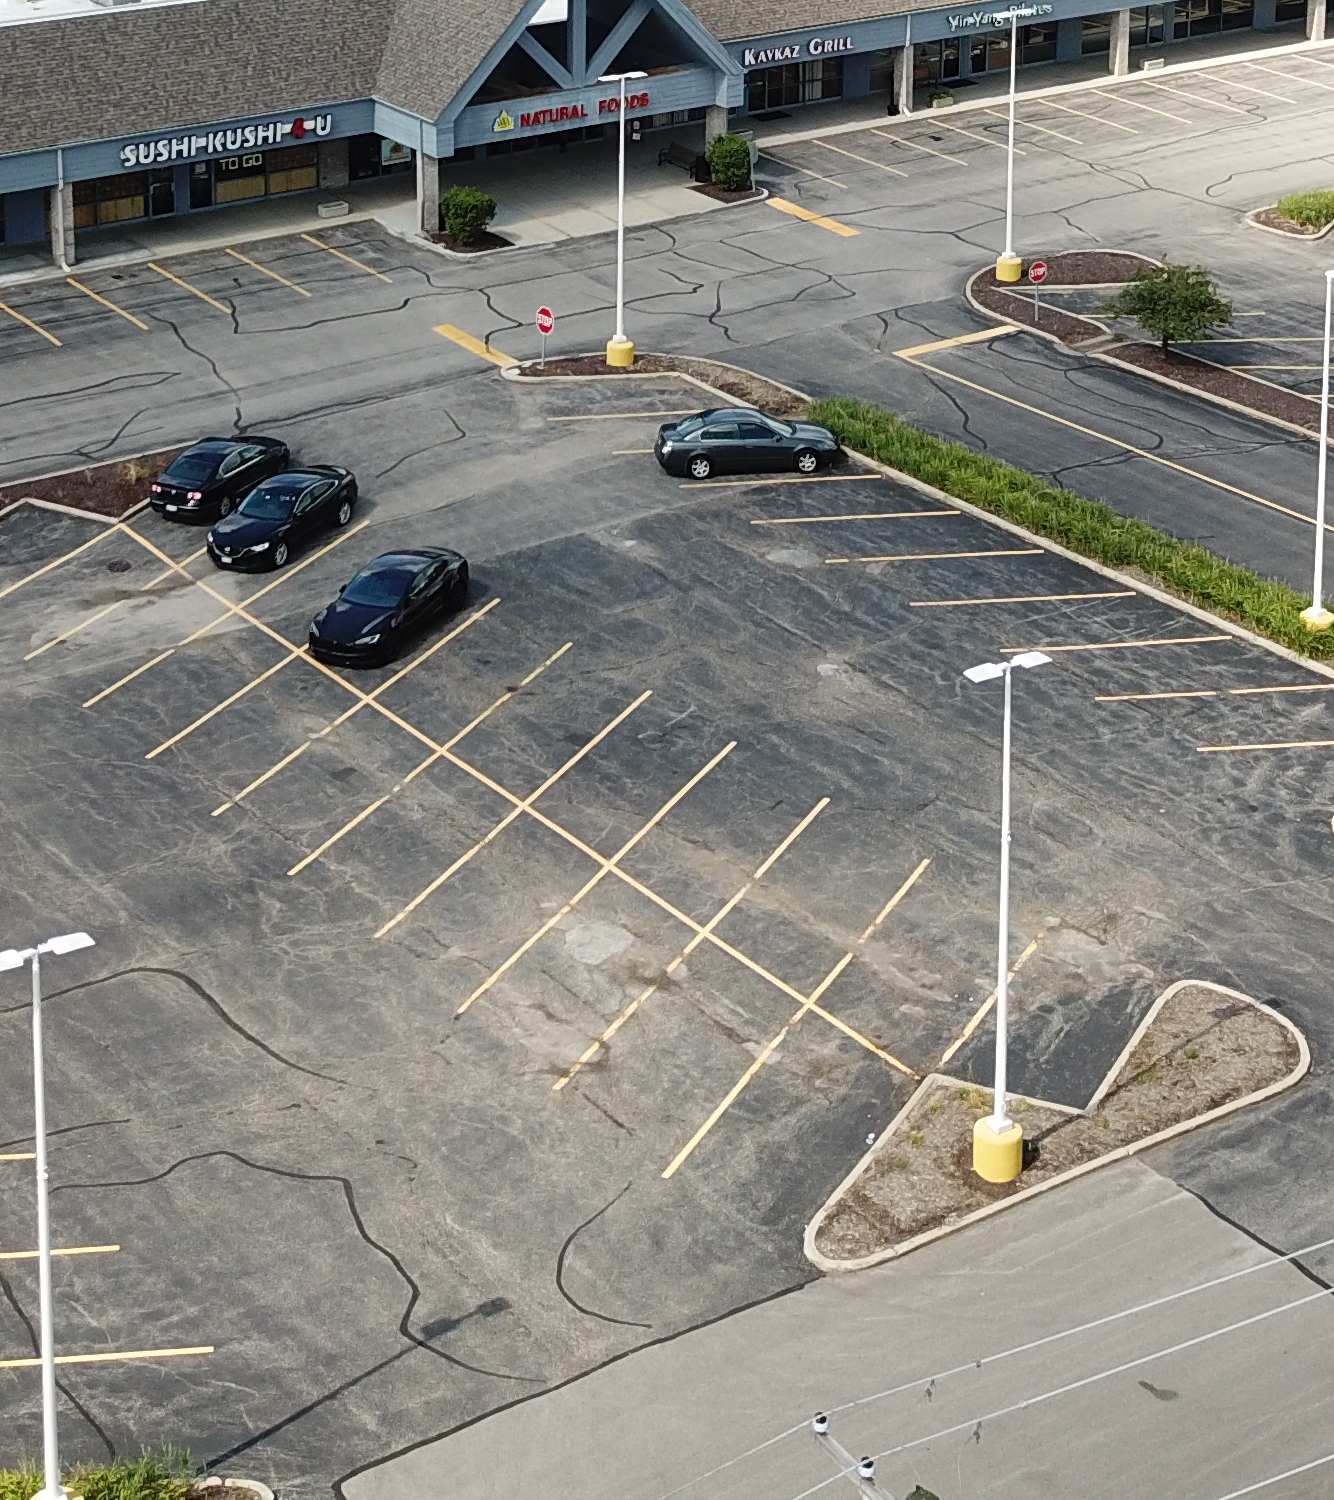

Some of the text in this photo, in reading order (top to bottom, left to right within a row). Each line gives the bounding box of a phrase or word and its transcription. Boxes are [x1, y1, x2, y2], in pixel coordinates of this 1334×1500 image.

[1009, 3, 1052, 22] Piltes
[744, 36, 854, 66] KAVKAZ GRILL
[520, 103, 588, 127] NATURAL
[123, 114, 332, 167] SUSHI KUSHI 4 U
[219, 153, 263, 171] TO GO
[1030, 267, 1046, 278] STOP
[537, 313, 553, 327] STOP
